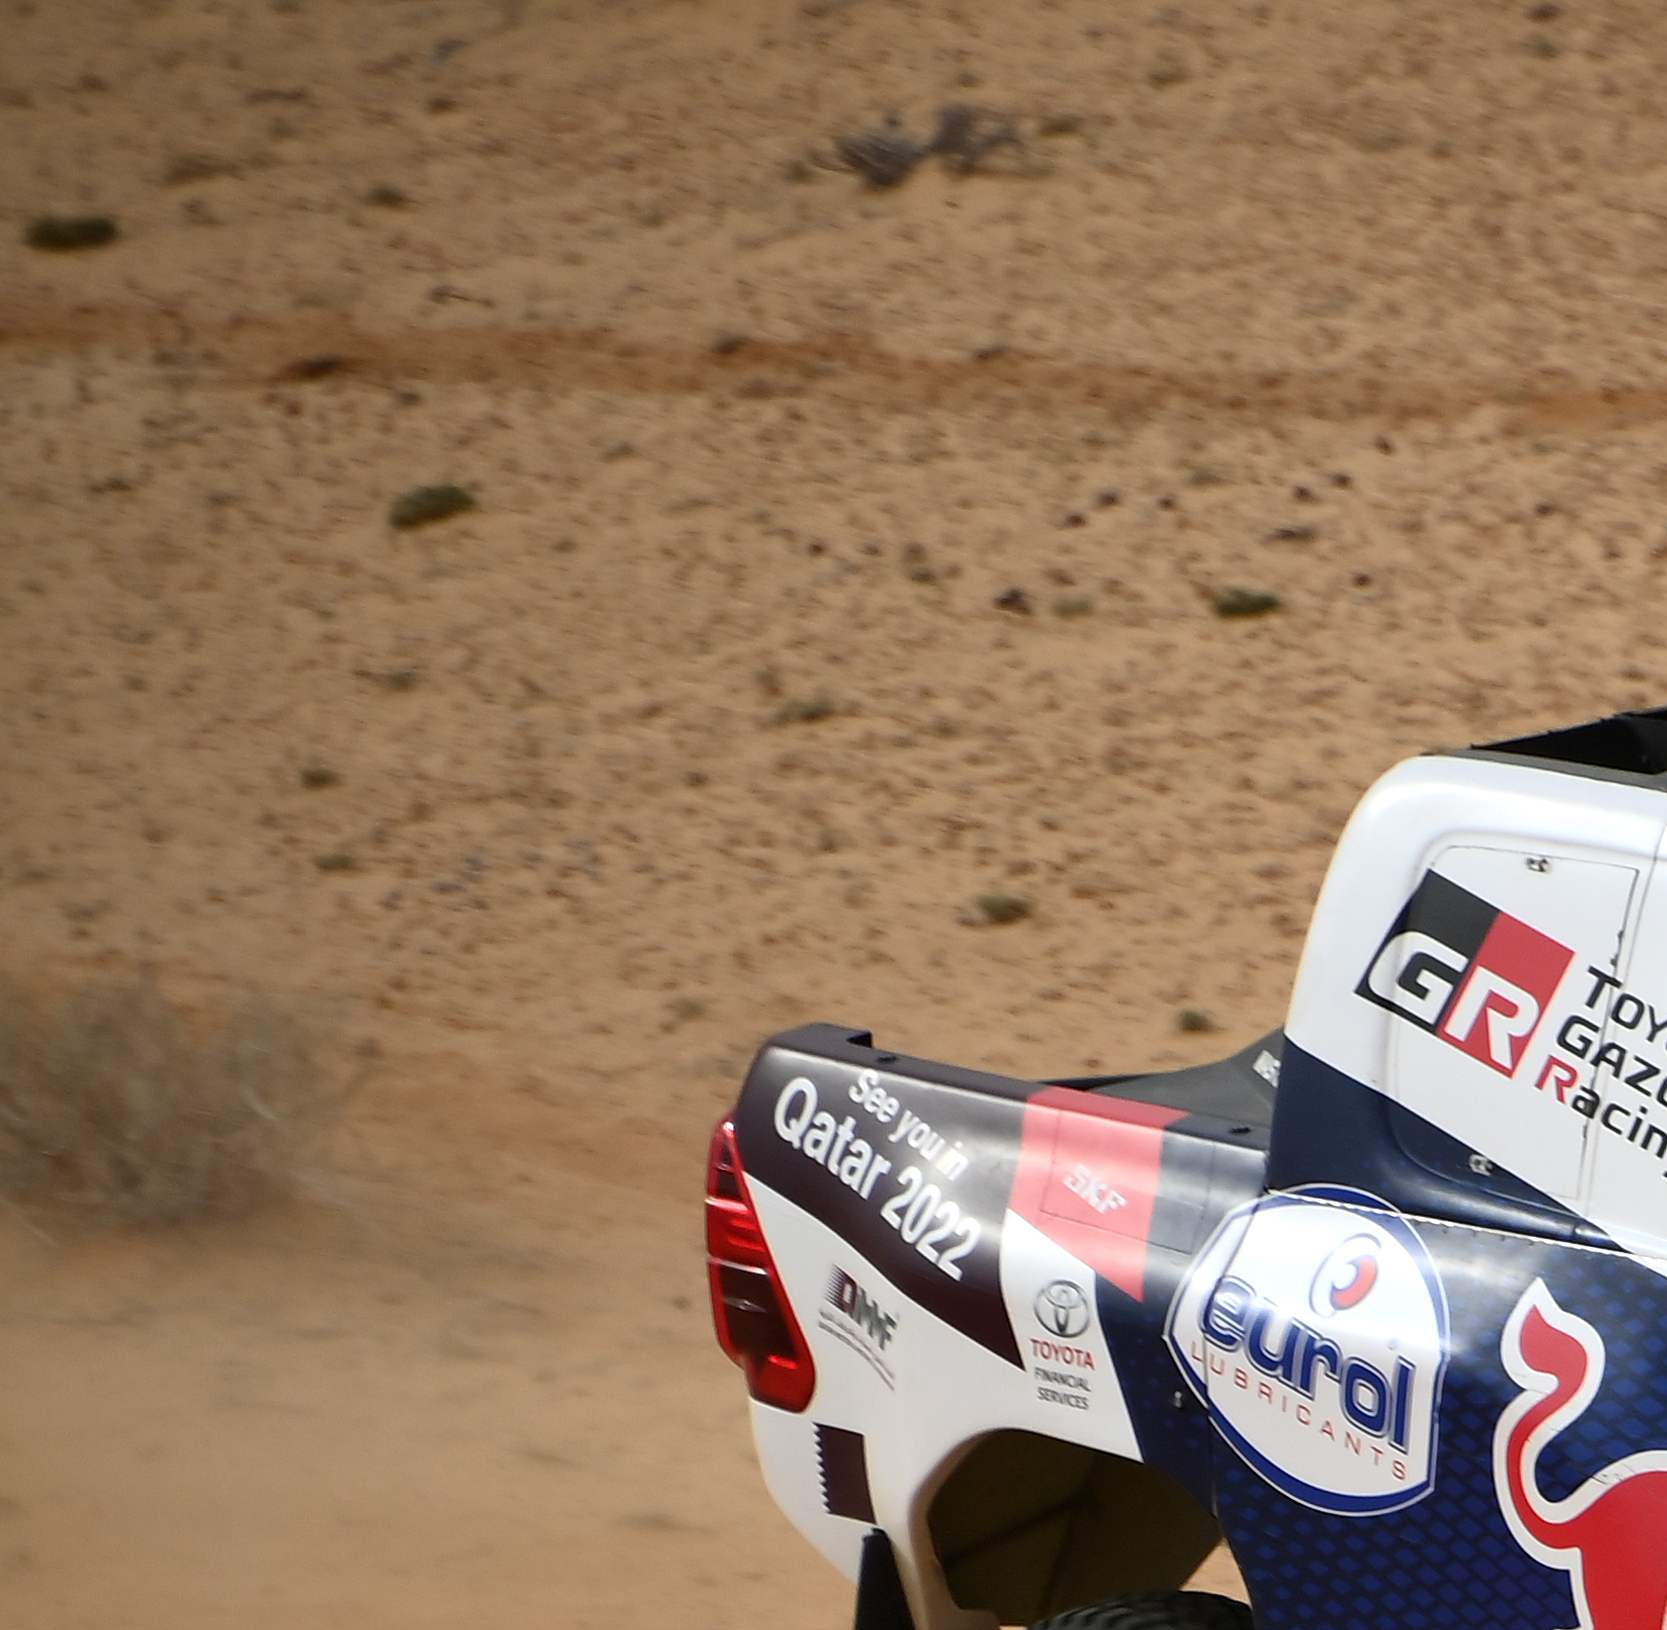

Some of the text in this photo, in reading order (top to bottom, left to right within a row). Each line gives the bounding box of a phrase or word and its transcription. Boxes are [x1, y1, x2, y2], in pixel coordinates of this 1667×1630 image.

[1368, 931, 1540, 1070] GR
[774, 1076, 981, 1282] Qatar 2022
[849, 1069, 969, 1181] See you in
[1063, 1162, 1128, 1214] SKF
[1030, 1338, 1096, 1371] TOYOTA
[1034, 1367, 1092, 1392] FINANCIAL
[1037, 1386, 1089, 1411] SERVICES
[1200, 1275, 1416, 1455] eurol
[1190, 1341, 1407, 1481] LUBRICANTS
